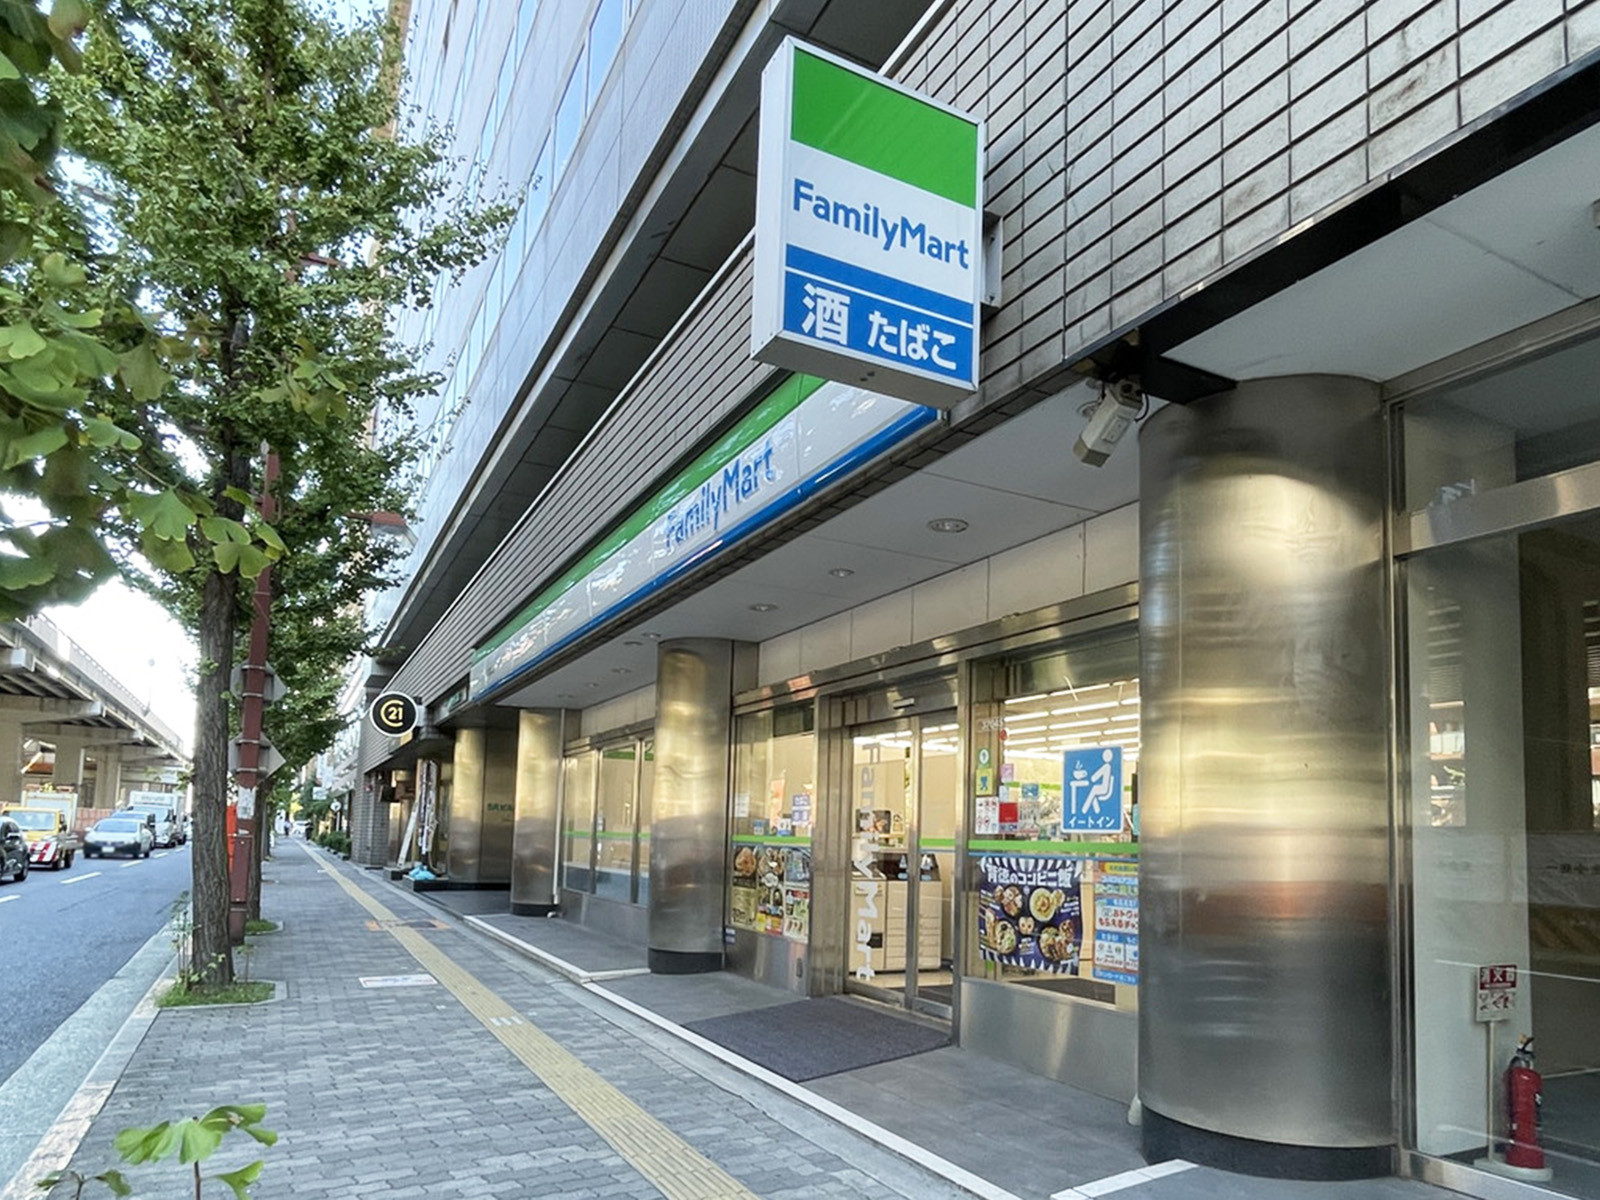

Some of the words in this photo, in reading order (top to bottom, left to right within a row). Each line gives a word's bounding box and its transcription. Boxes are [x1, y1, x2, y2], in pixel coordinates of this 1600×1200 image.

[793, 178, 969, 270] FamilyMart
[802, 283, 850, 346] 酒
[867, 310, 957, 370] たばこ
[665, 438, 774, 549] FamilyMart
[1068, 816, 1115, 829] イートイン
